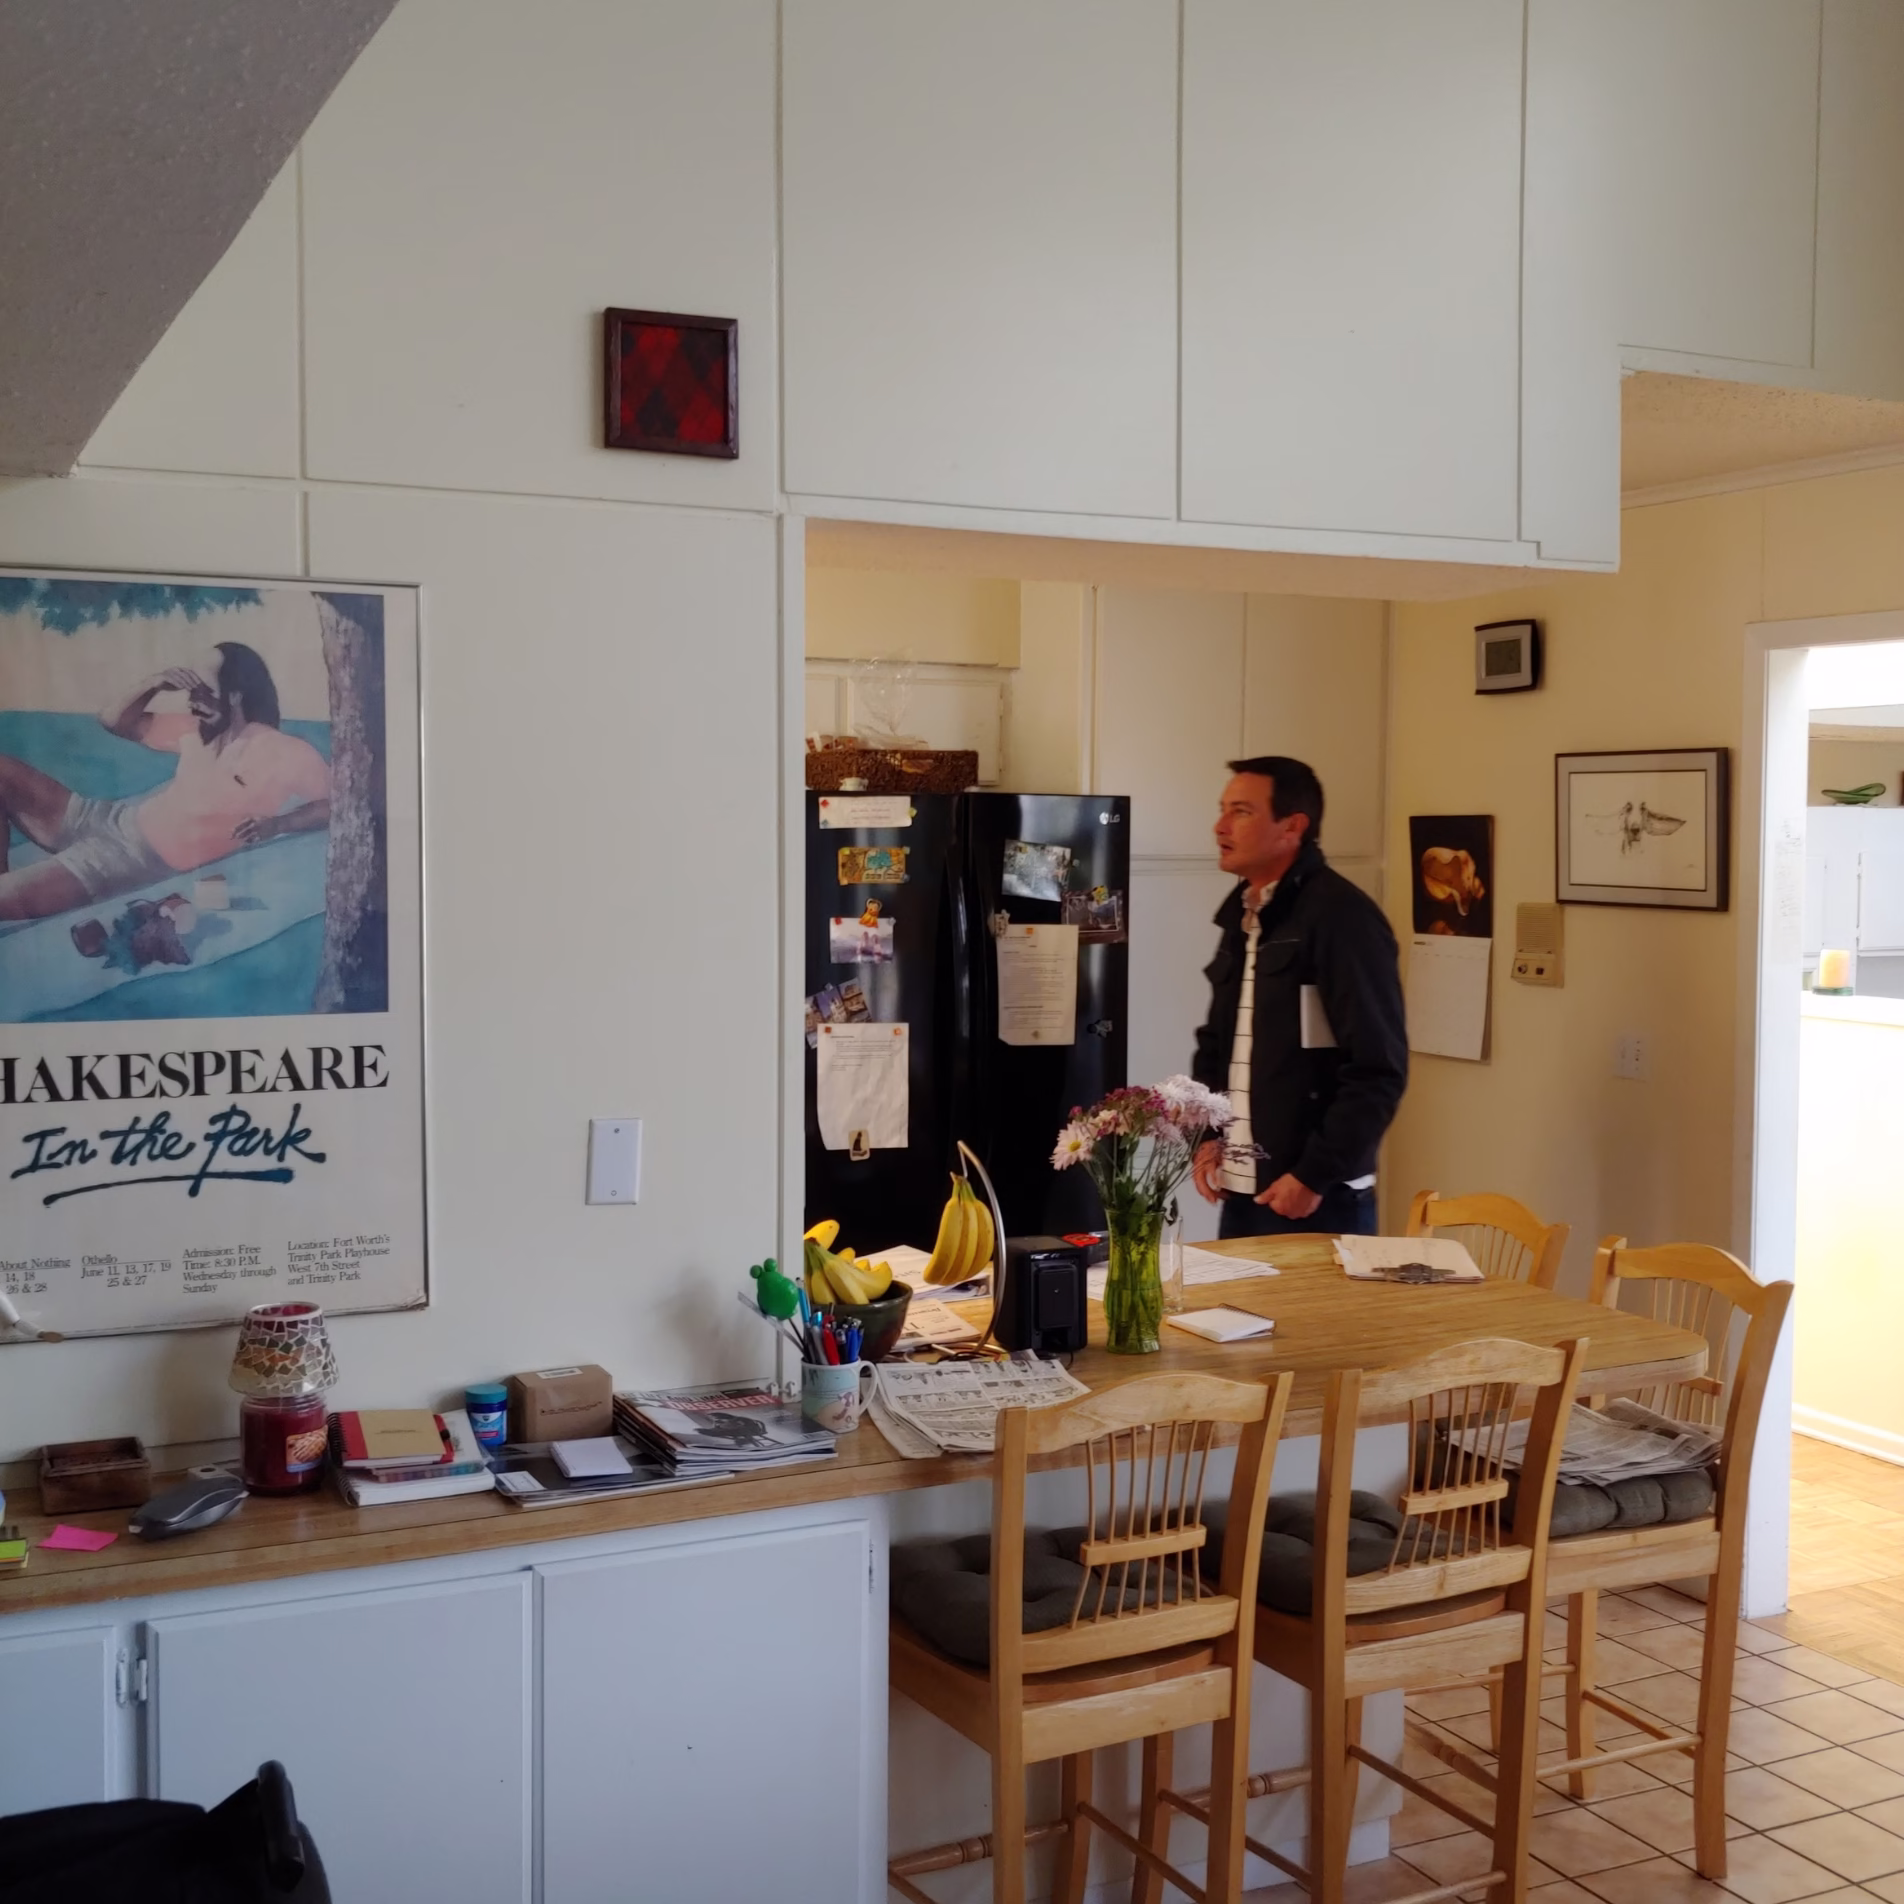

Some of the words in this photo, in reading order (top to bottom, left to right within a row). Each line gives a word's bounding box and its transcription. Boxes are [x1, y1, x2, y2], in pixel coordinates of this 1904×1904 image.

[10, 1126, 98, 1180] In
[99, 1110, 197, 1167] the
[188, 1102, 327, 1198] Park
[287, 1240, 330, 1251] Location:
[333, 1237, 354, 1248] Fort
[356, 1234, 390, 1246] Worth's
[182, 1248, 235, 1259] Admission:
[238, 1244, 262, 1255] Free
[287, 1251, 317, 1263] Trinity
[320, 1249, 342, 1260] Park
[345, 1247, 390, 1259] Playhouse
[0, 1260, 28, 1270] About
[31, 1257, 71, 1269] Nothing
[81, 1254, 118, 1265] Othello
[182, 1260, 211, 1270] Time:
[214, 1257, 237, 1268] 8:30
[287, 1263, 312, 1273] West
[314, 1262, 330, 1272] 7th
[331, 1260, 361, 1270] Street
[24, 1271, 36, 1282] 18
[80, 1267, 104, 1279] June
[160, 1262, 172, 1272] 19
[183, 1269, 238, 1281] Wednesday
[240, 1265, 277, 1278] through
[287, 1275, 305, 1285] and
[306, 1273, 337, 1284] Trinity
[339, 1270, 362, 1281] Park
[107, 1277, 120, 1288] 25
[122, 1276, 132, 1287] &
[134, 1275, 148, 1286] 27
[182, 1282, 218, 1294] Sunday
[22, 1284, 32, 1294] &
[666, 1394, 775, 1412] OBSERVER
